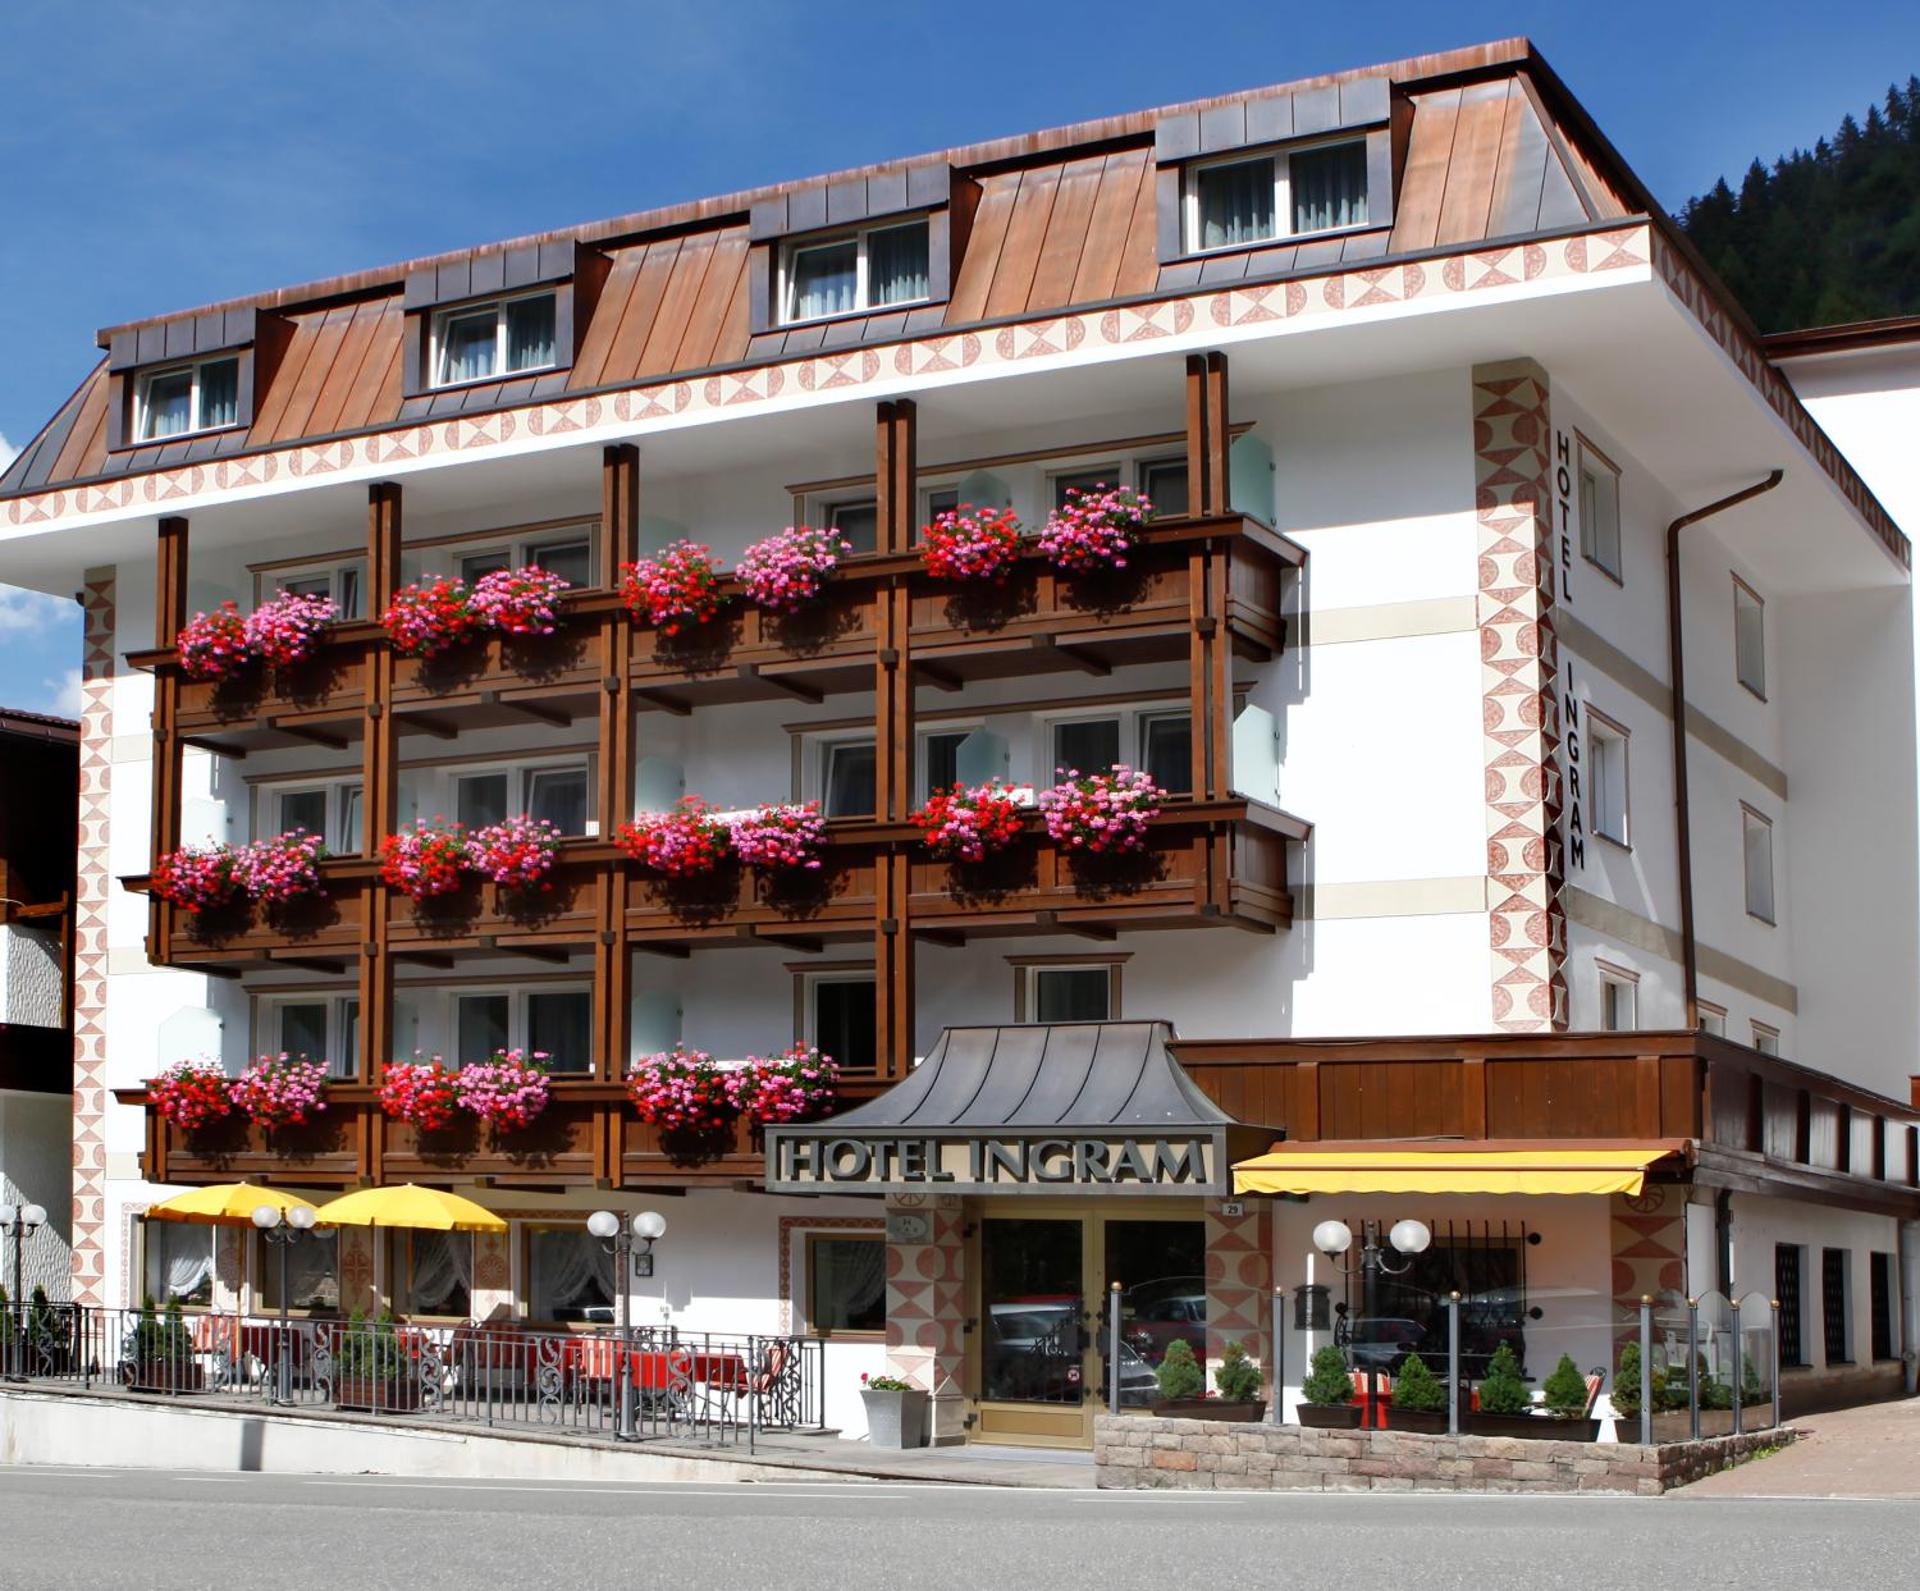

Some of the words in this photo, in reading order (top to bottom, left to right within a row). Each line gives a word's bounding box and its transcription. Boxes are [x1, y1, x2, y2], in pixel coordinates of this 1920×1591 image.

[1556, 429, 1573, 603] HOTEL
[1564, 661, 1585, 870] INGRAM
[783, 1138, 955, 1179] HOTEL
[968, 1139, 1207, 1180] INGRAM
[1227, 1204, 1239, 1214] 29
